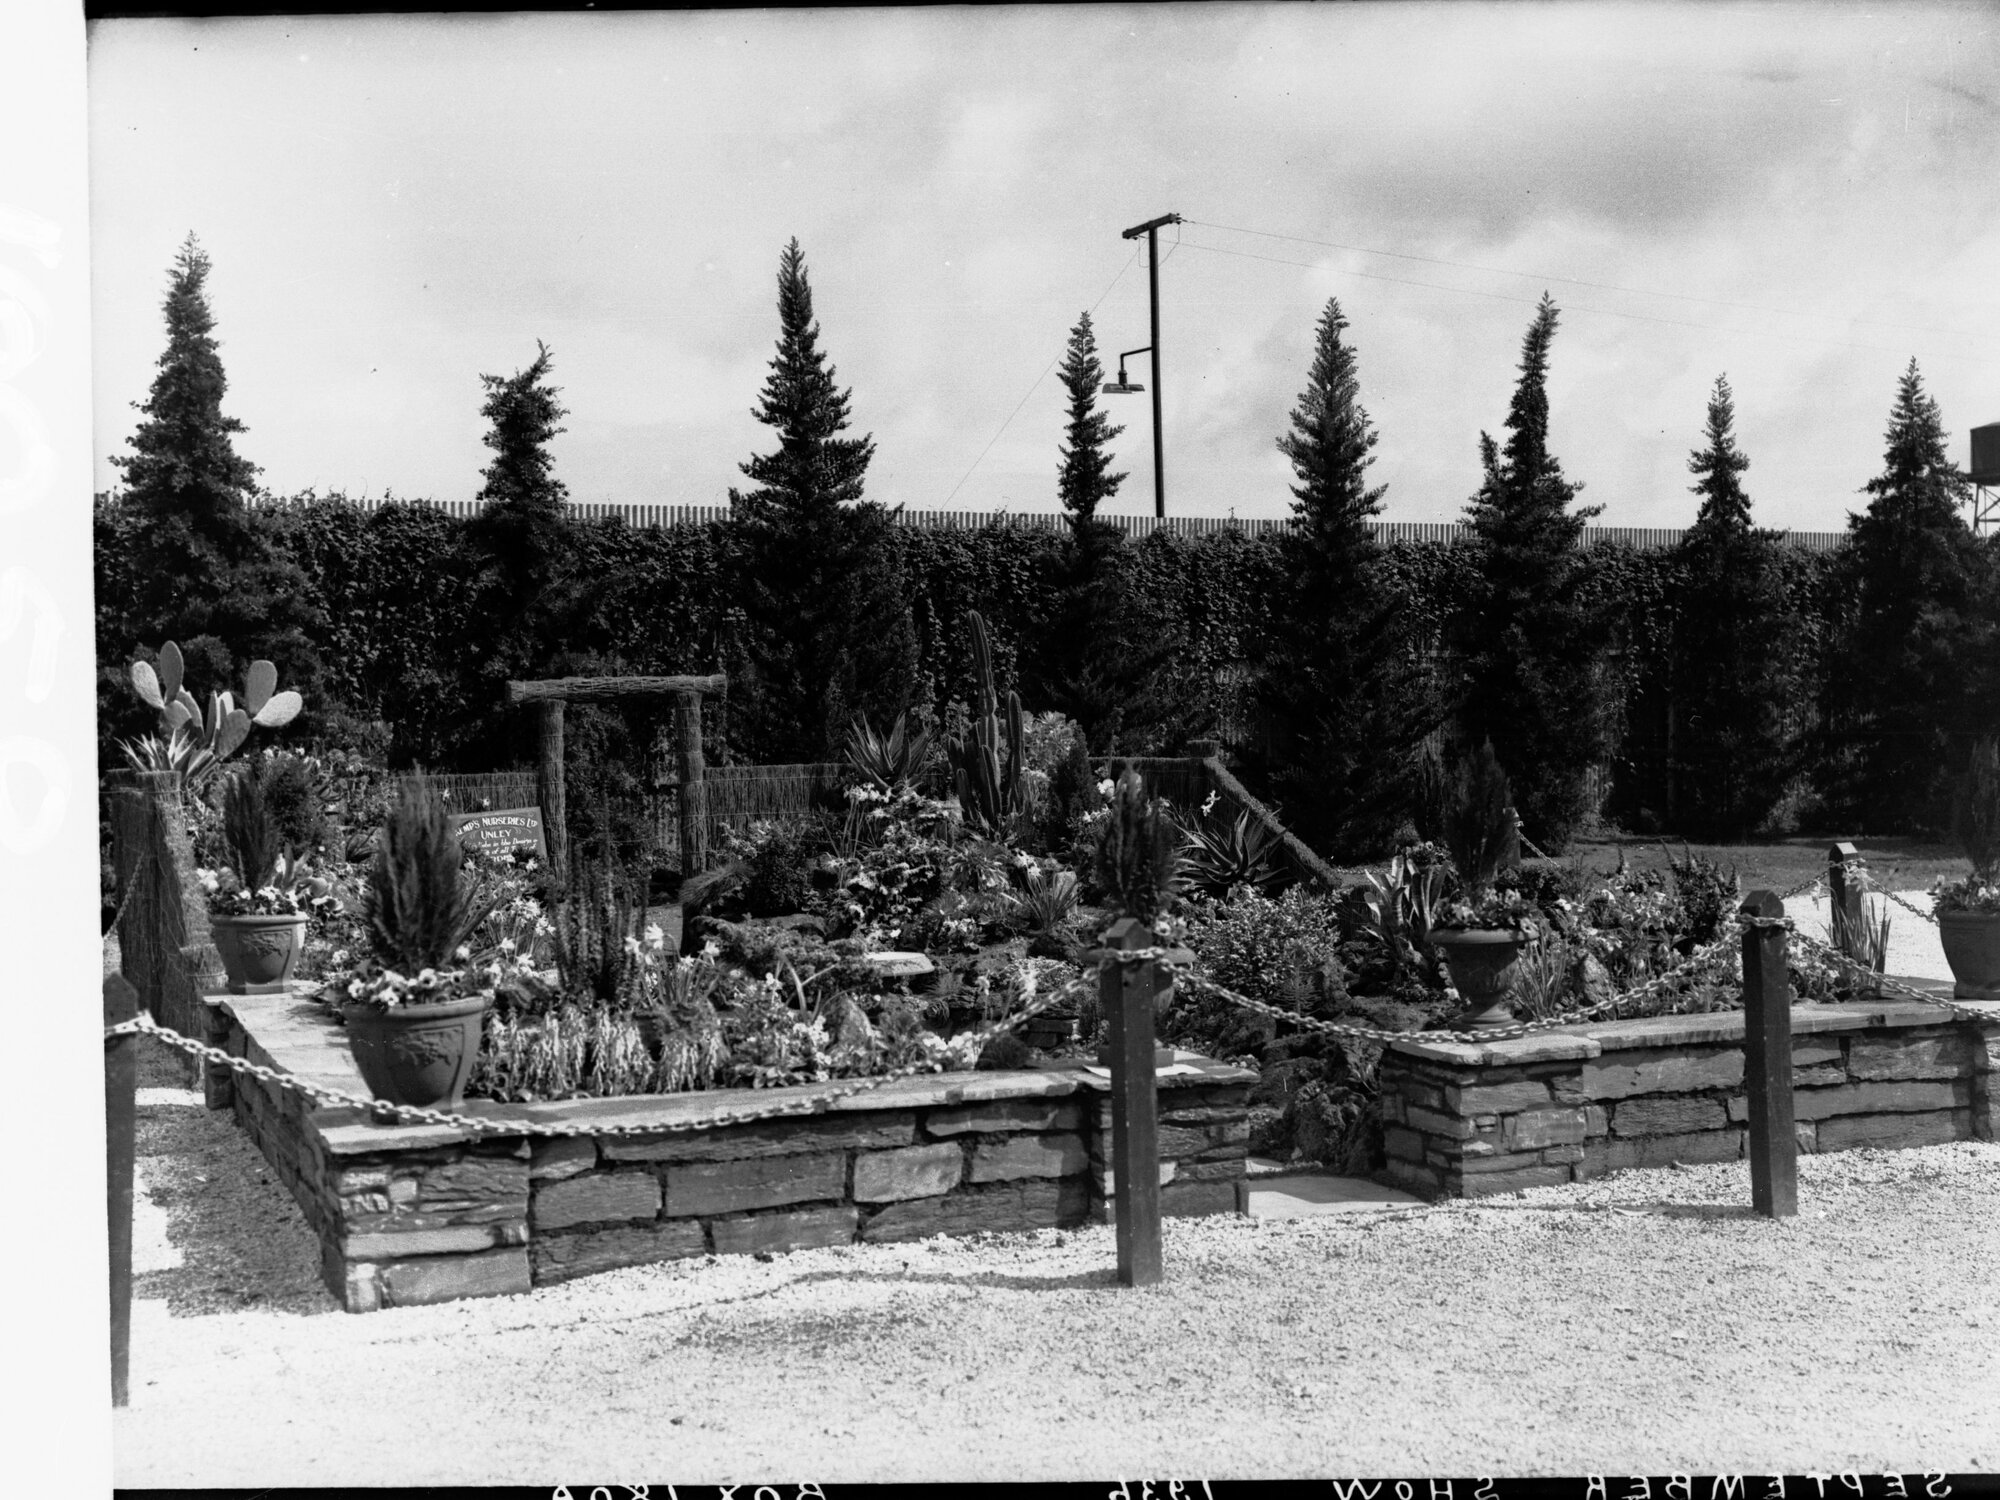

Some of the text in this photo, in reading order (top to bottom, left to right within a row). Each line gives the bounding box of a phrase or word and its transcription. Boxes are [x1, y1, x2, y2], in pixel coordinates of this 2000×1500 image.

[482, 817, 525, 826] NURSERIES
[527, 818, 538, 828] LTD
[481, 829, 511, 839] UNLEY
